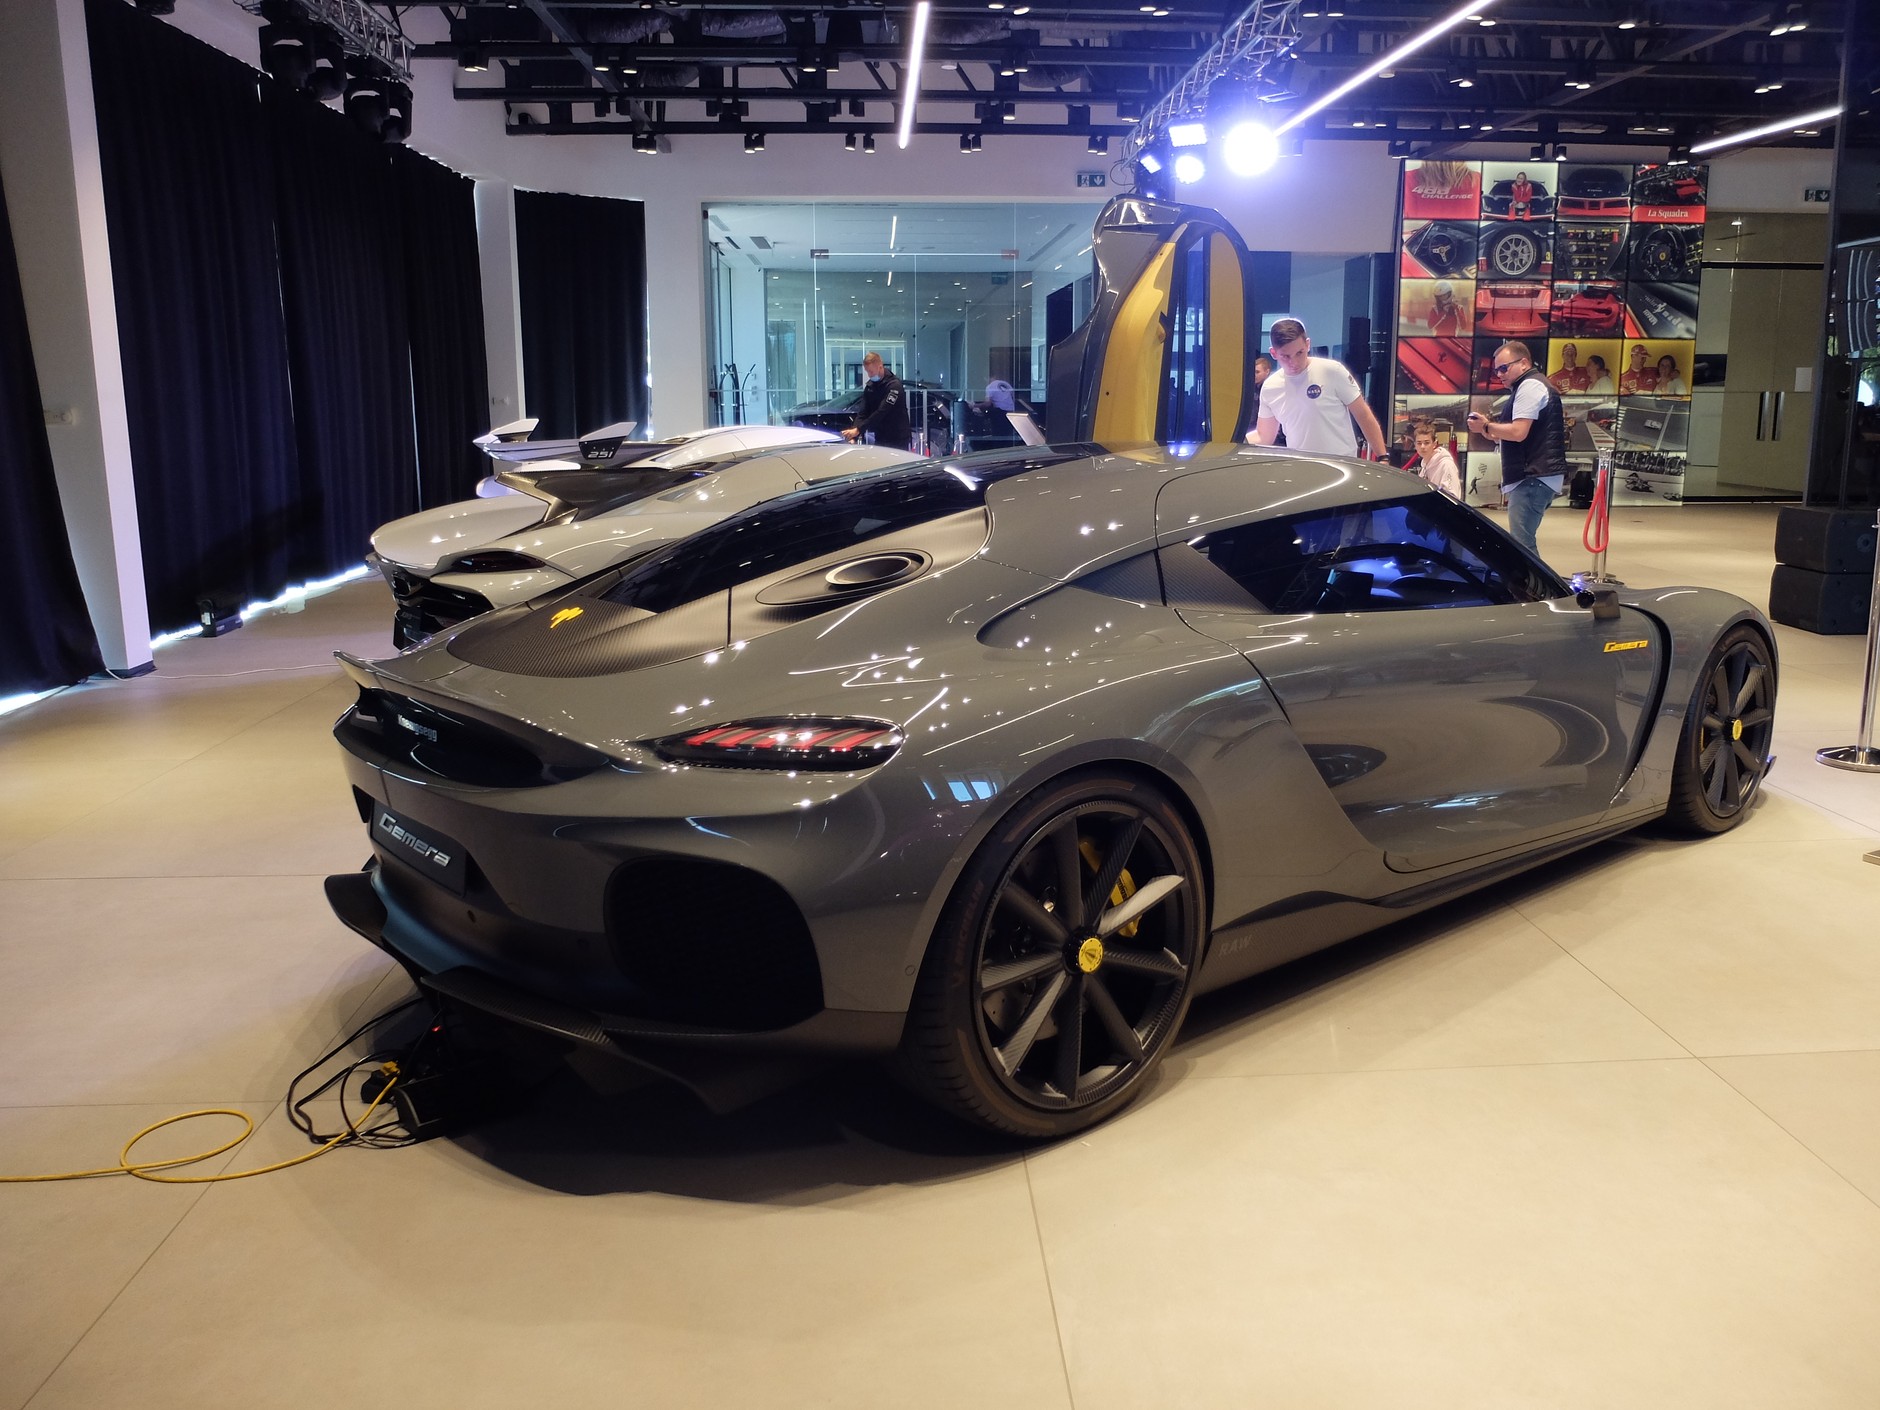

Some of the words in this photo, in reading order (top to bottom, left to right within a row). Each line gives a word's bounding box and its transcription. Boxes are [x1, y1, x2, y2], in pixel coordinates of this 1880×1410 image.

[1647, 209, 1656, 217] La
[1657, 208, 1689, 218] Squadra
[587, 450, 614, 459] 251
[1603, 640, 1649, 653] Gemera
[379, 812, 452, 867] Gemera
